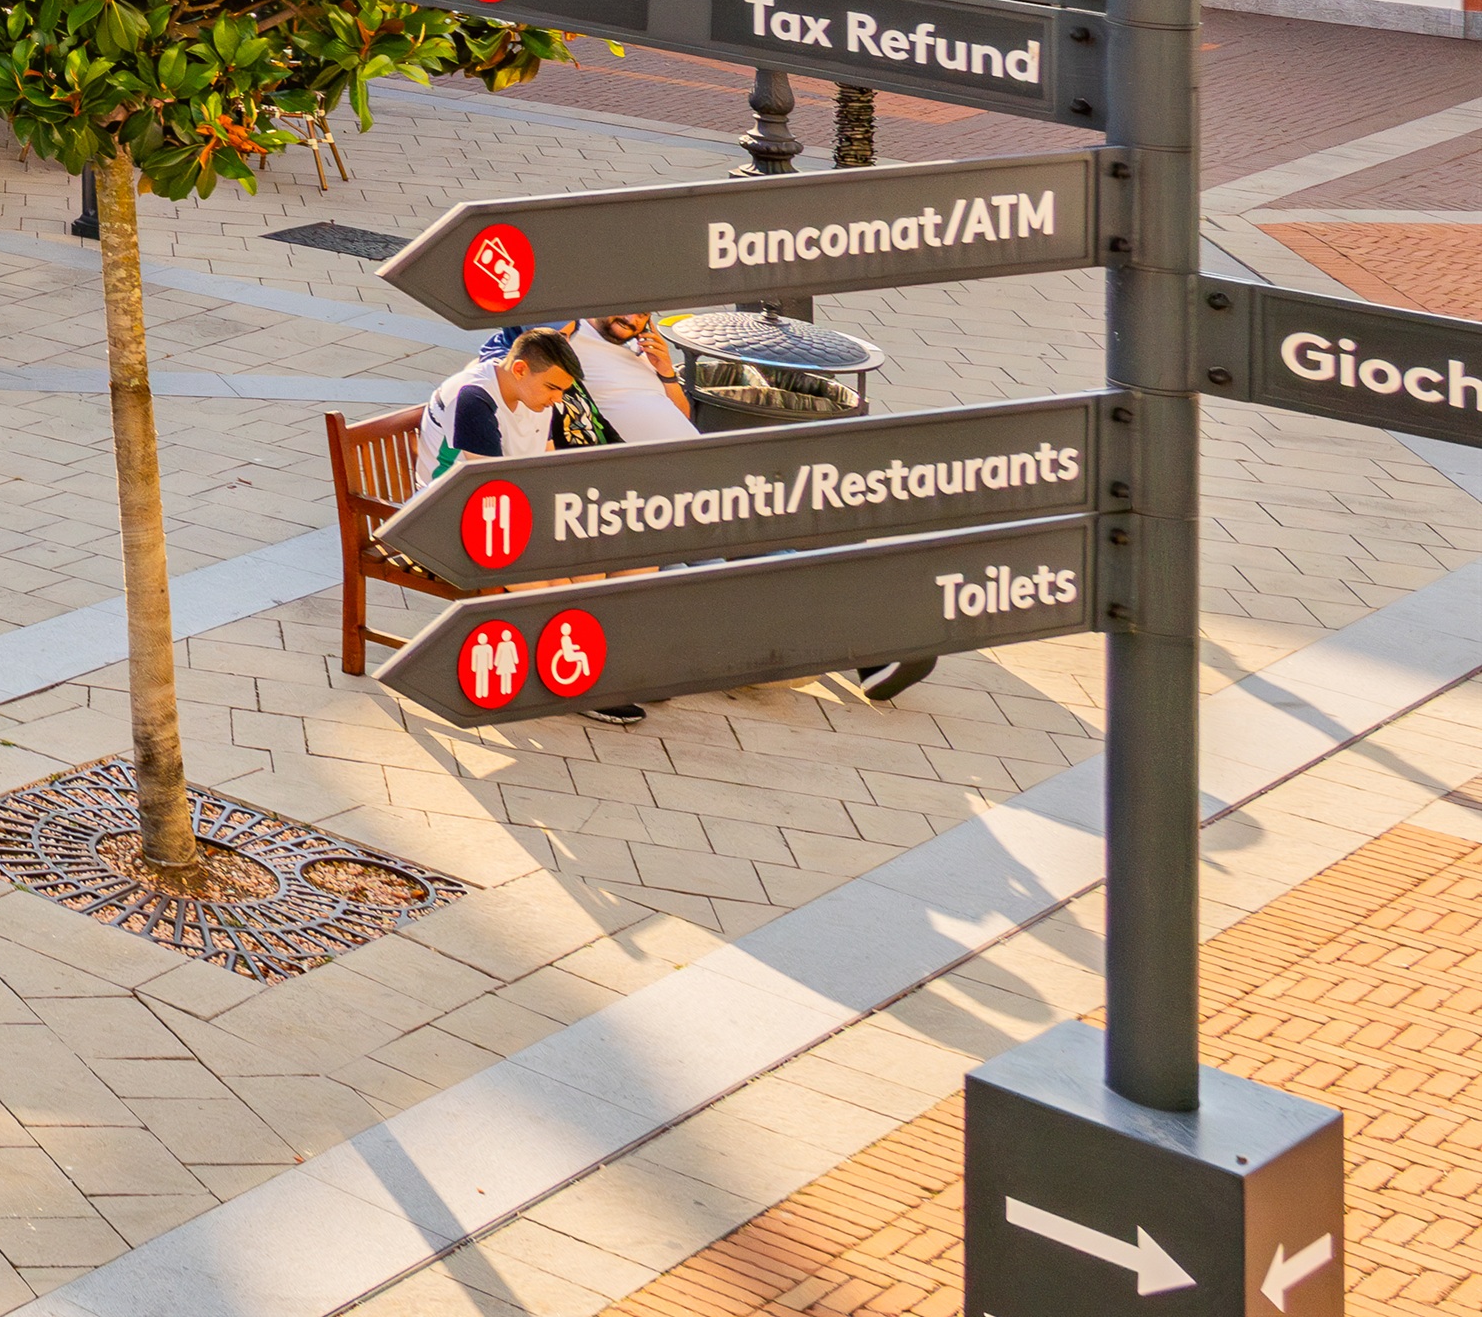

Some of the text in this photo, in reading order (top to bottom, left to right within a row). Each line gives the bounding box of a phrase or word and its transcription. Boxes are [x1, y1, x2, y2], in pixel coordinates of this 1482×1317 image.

[846, 10, 1041, 85] Refund
[707, 189, 1055, 270] Bancomat/ATM
[1280, 331, 1482, 412] Gioch
[935, 565, 1079, 621] Toilets
